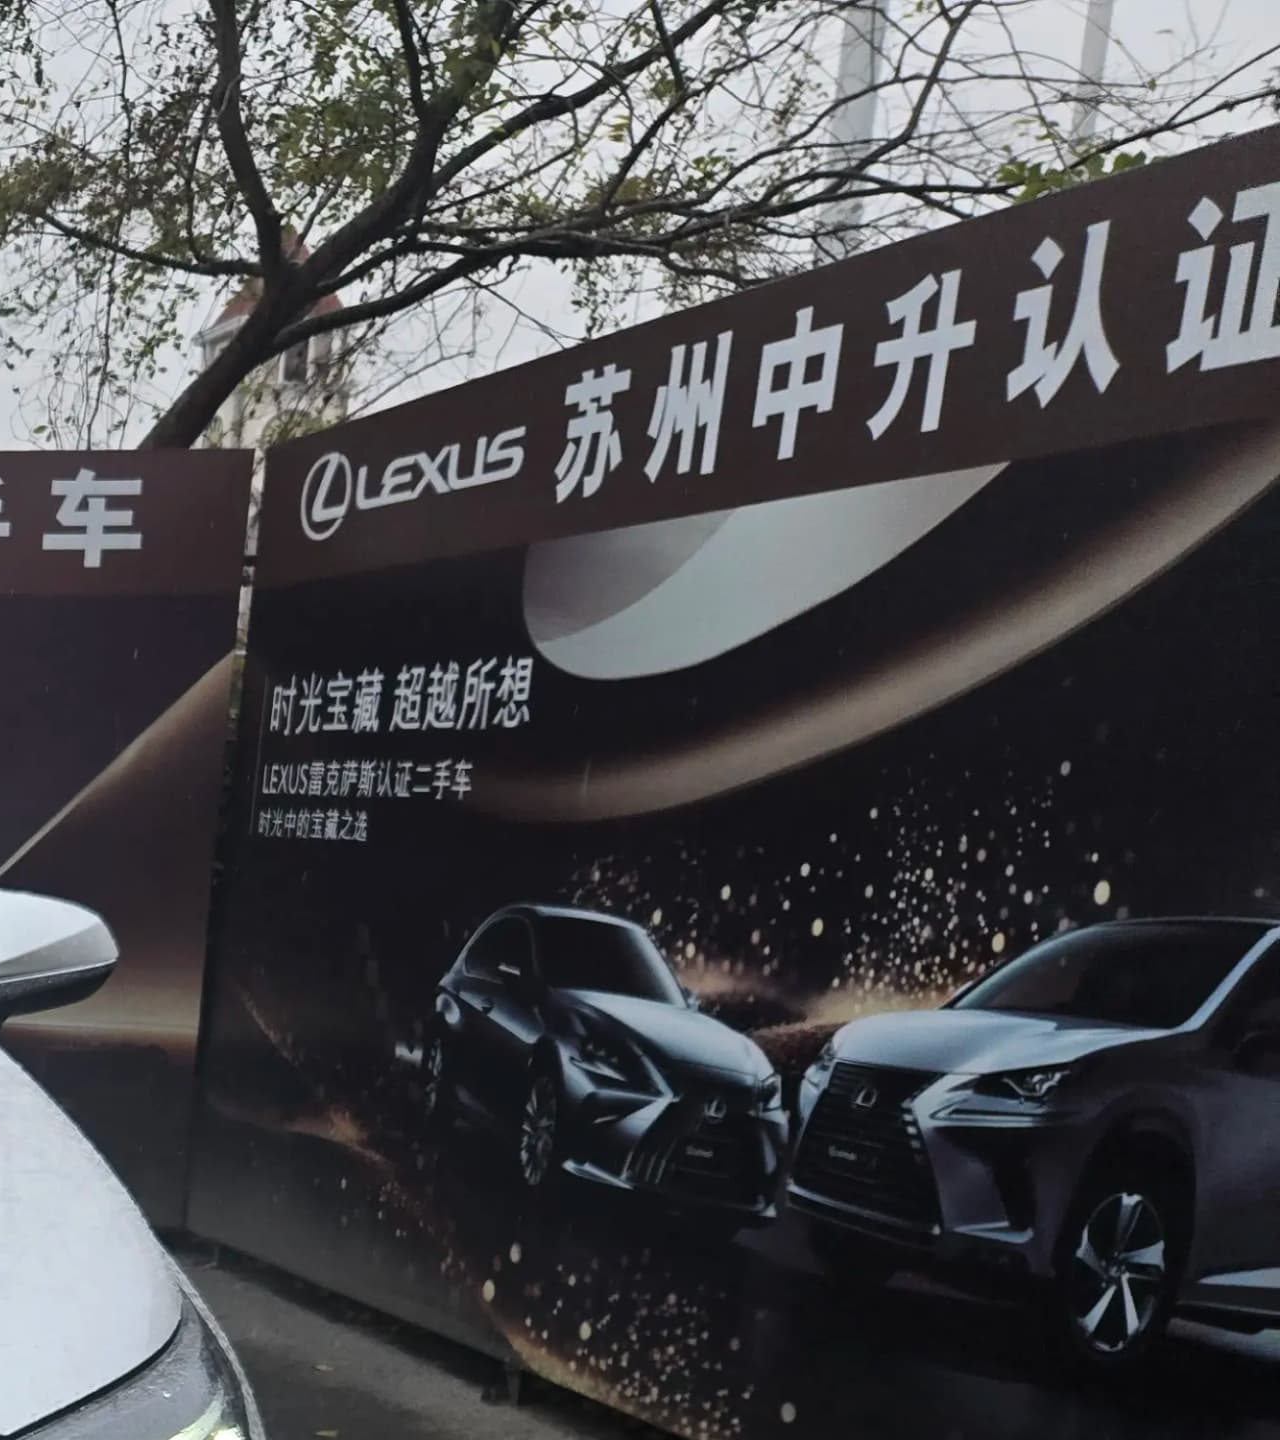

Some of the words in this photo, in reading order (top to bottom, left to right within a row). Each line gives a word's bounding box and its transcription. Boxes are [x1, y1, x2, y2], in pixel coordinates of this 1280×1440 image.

[355, 425, 526, 512] LEXUS
[555, 181, 1280, 504] 苏州中升认证
[270, 666, 384, 736] 时光宝藏
[389, 655, 533, 731] 超越所想
[262, 757, 473, 799] LEXUS雷克萨斯认证二手车
[258, 808, 368, 841] 时光中的宝藏之选
